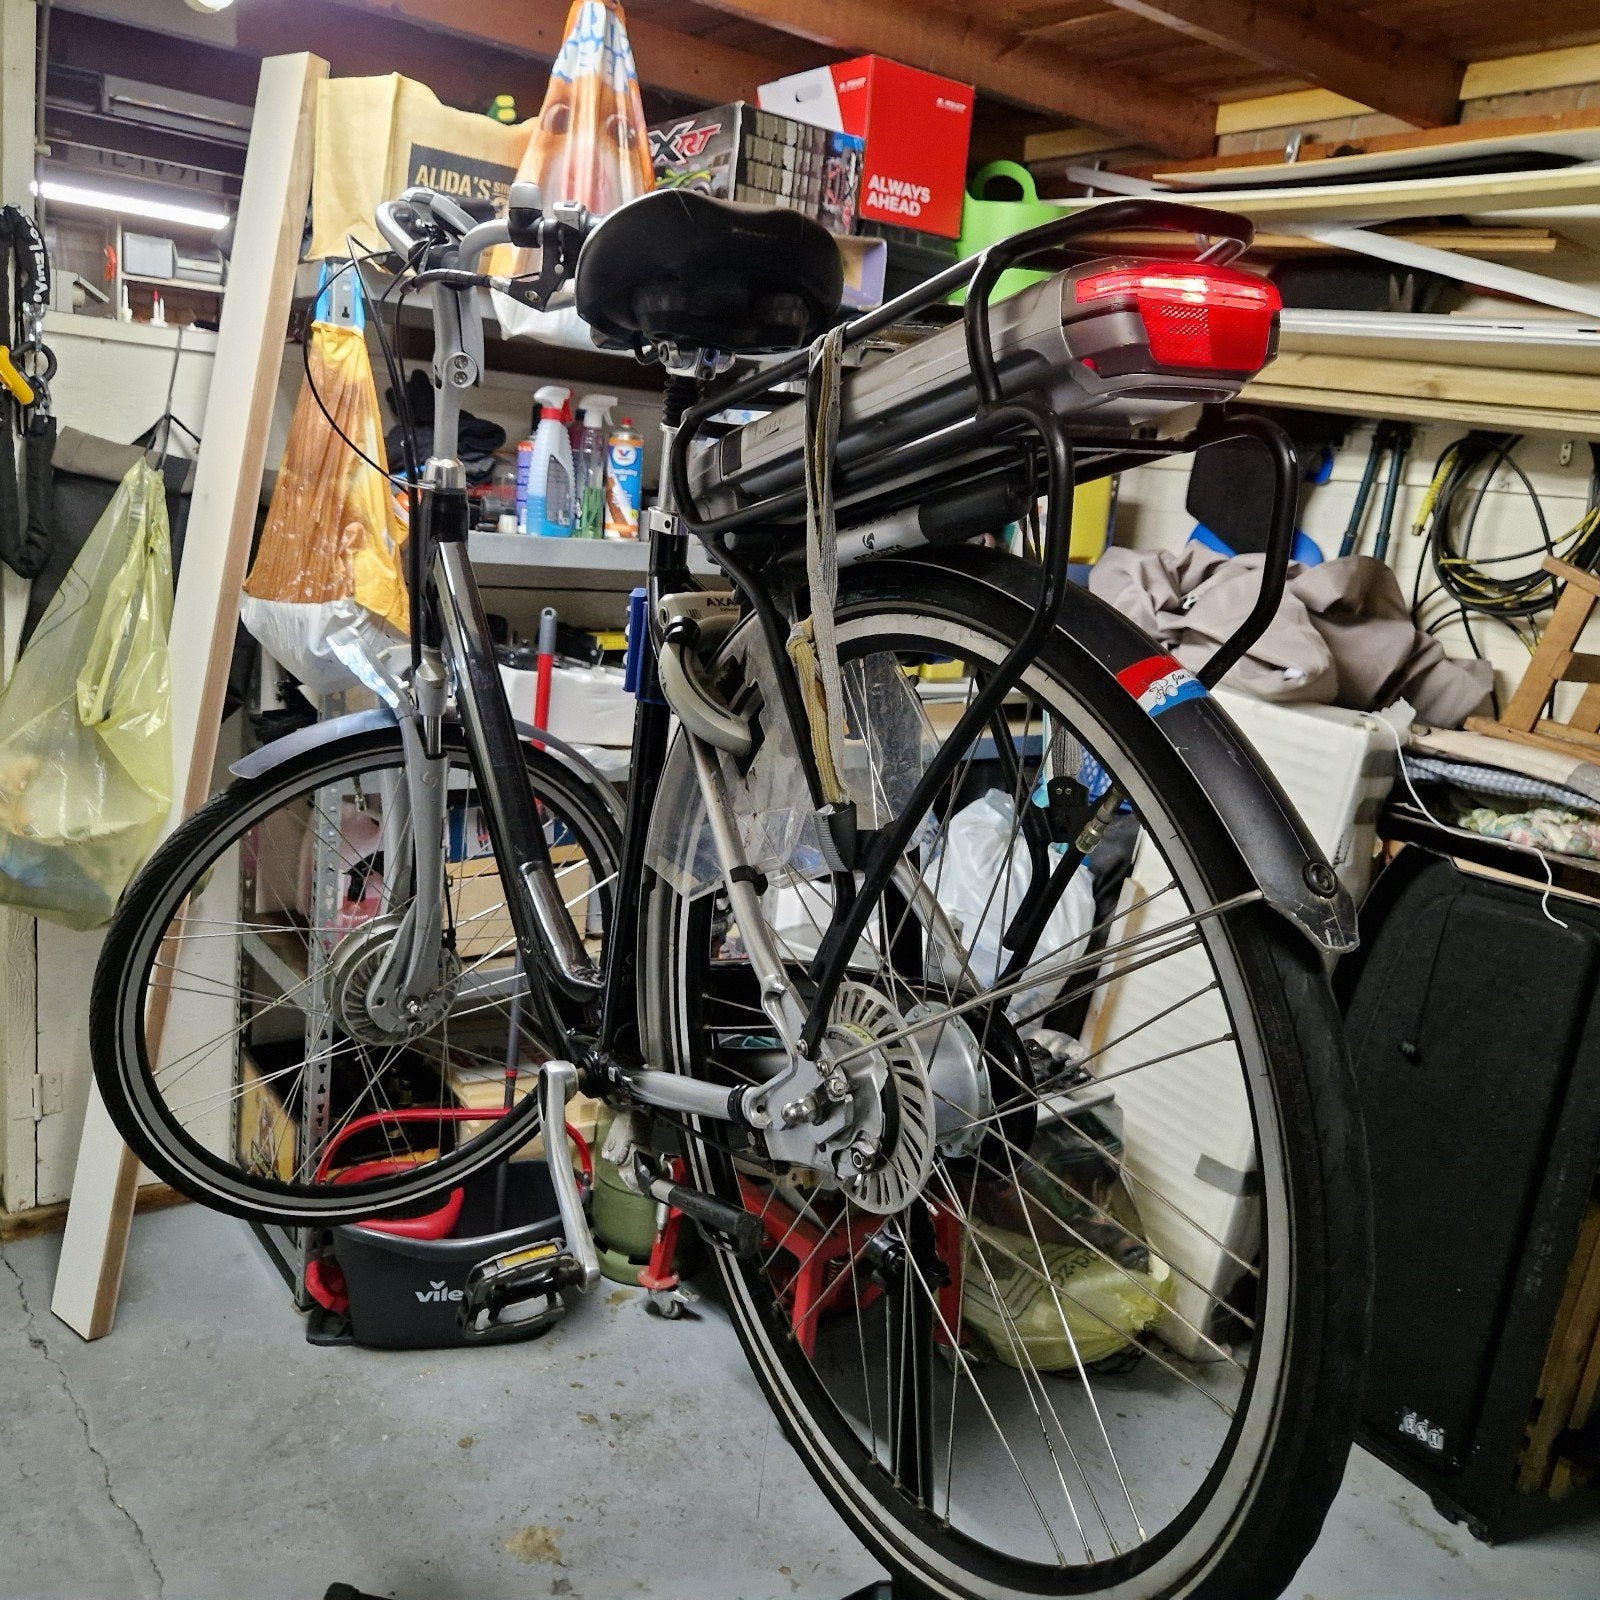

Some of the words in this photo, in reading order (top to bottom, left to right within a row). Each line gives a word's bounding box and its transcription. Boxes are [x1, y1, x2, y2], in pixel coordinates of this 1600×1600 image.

[414, 164, 492, 201] ALIDA'S
[867, 173, 931, 204] ALWAYS
[865, 190, 922, 217] AHEAD
[706, 597, 740, 607] AXA
[415, 1281, 464, 1303] vile
